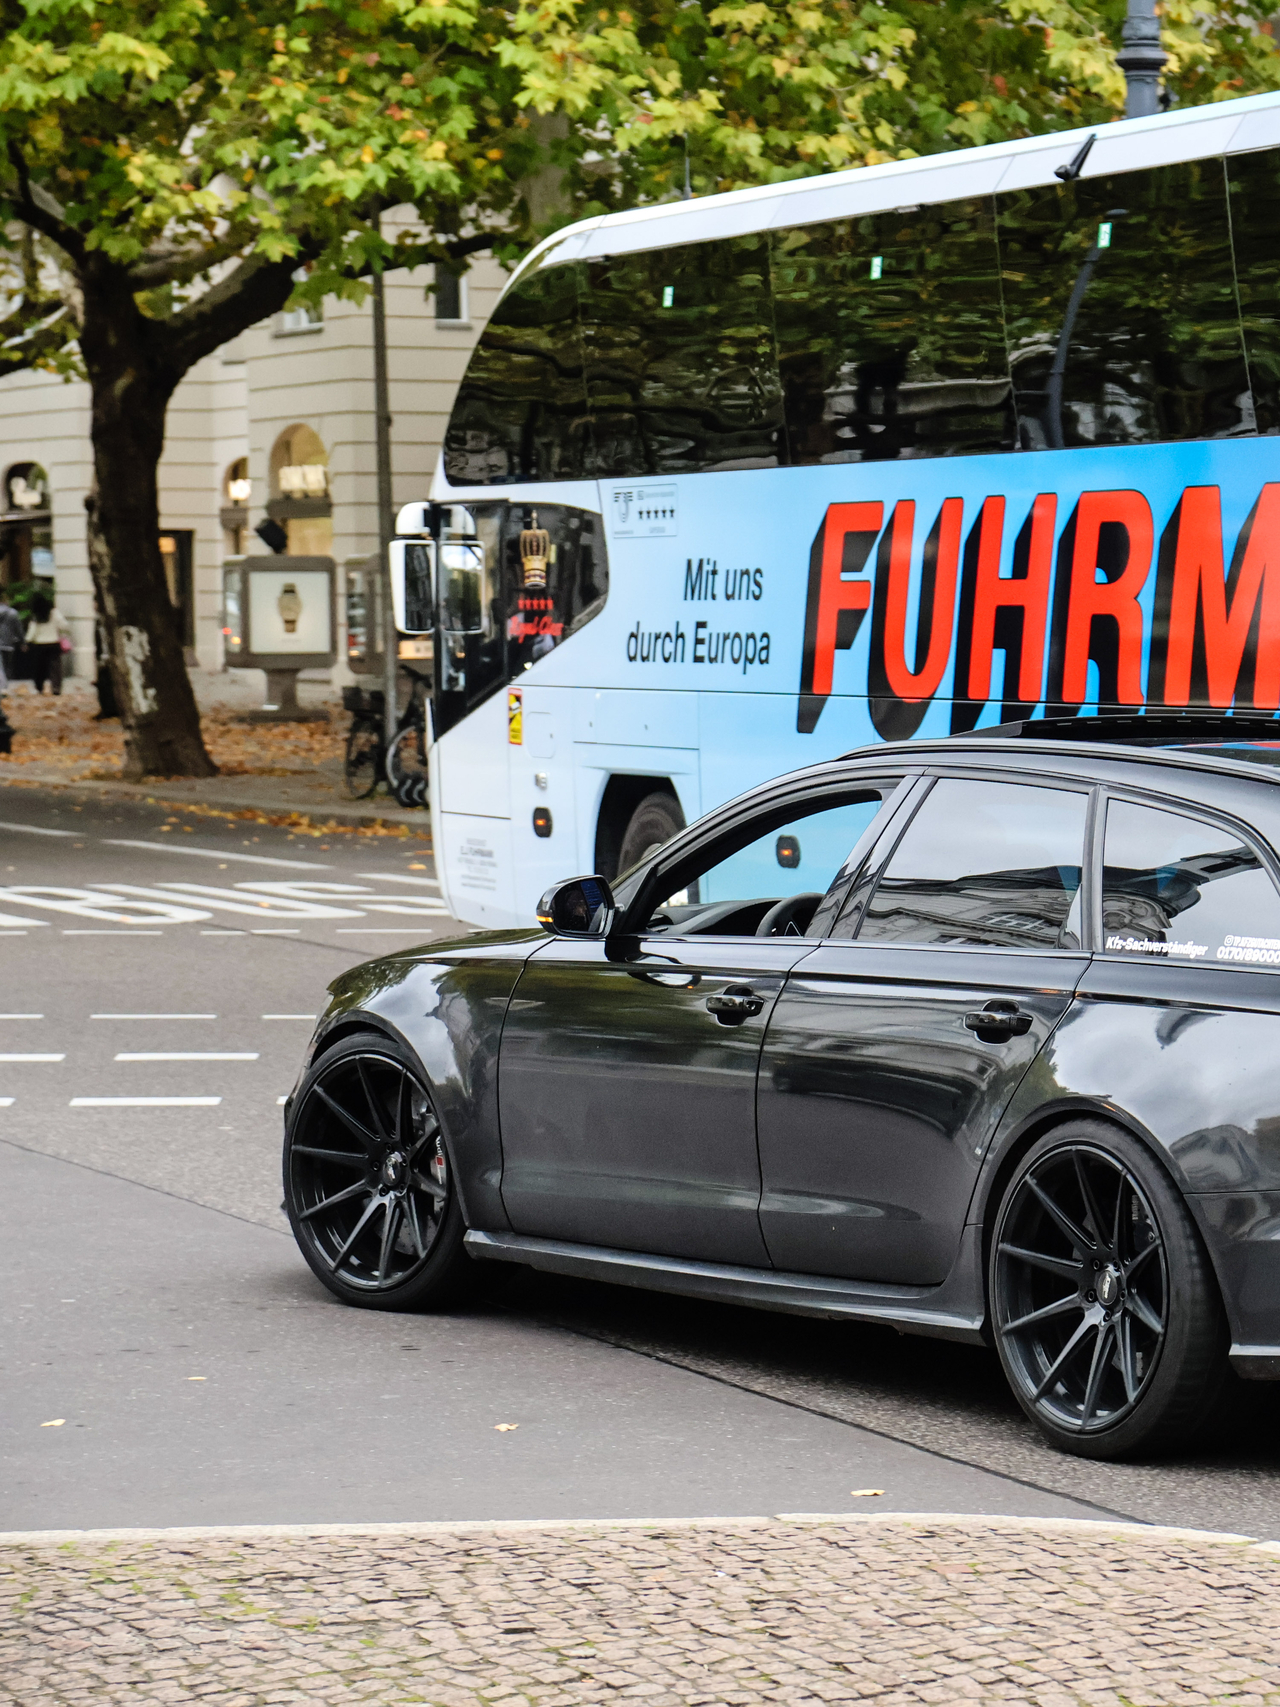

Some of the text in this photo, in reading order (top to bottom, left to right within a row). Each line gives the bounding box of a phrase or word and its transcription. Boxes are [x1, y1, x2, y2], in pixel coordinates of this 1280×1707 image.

[683, 559, 763, 601] Mit uns
[627, 621, 770, 674] durch Europa
[0, 881, 455, 925] BUS
